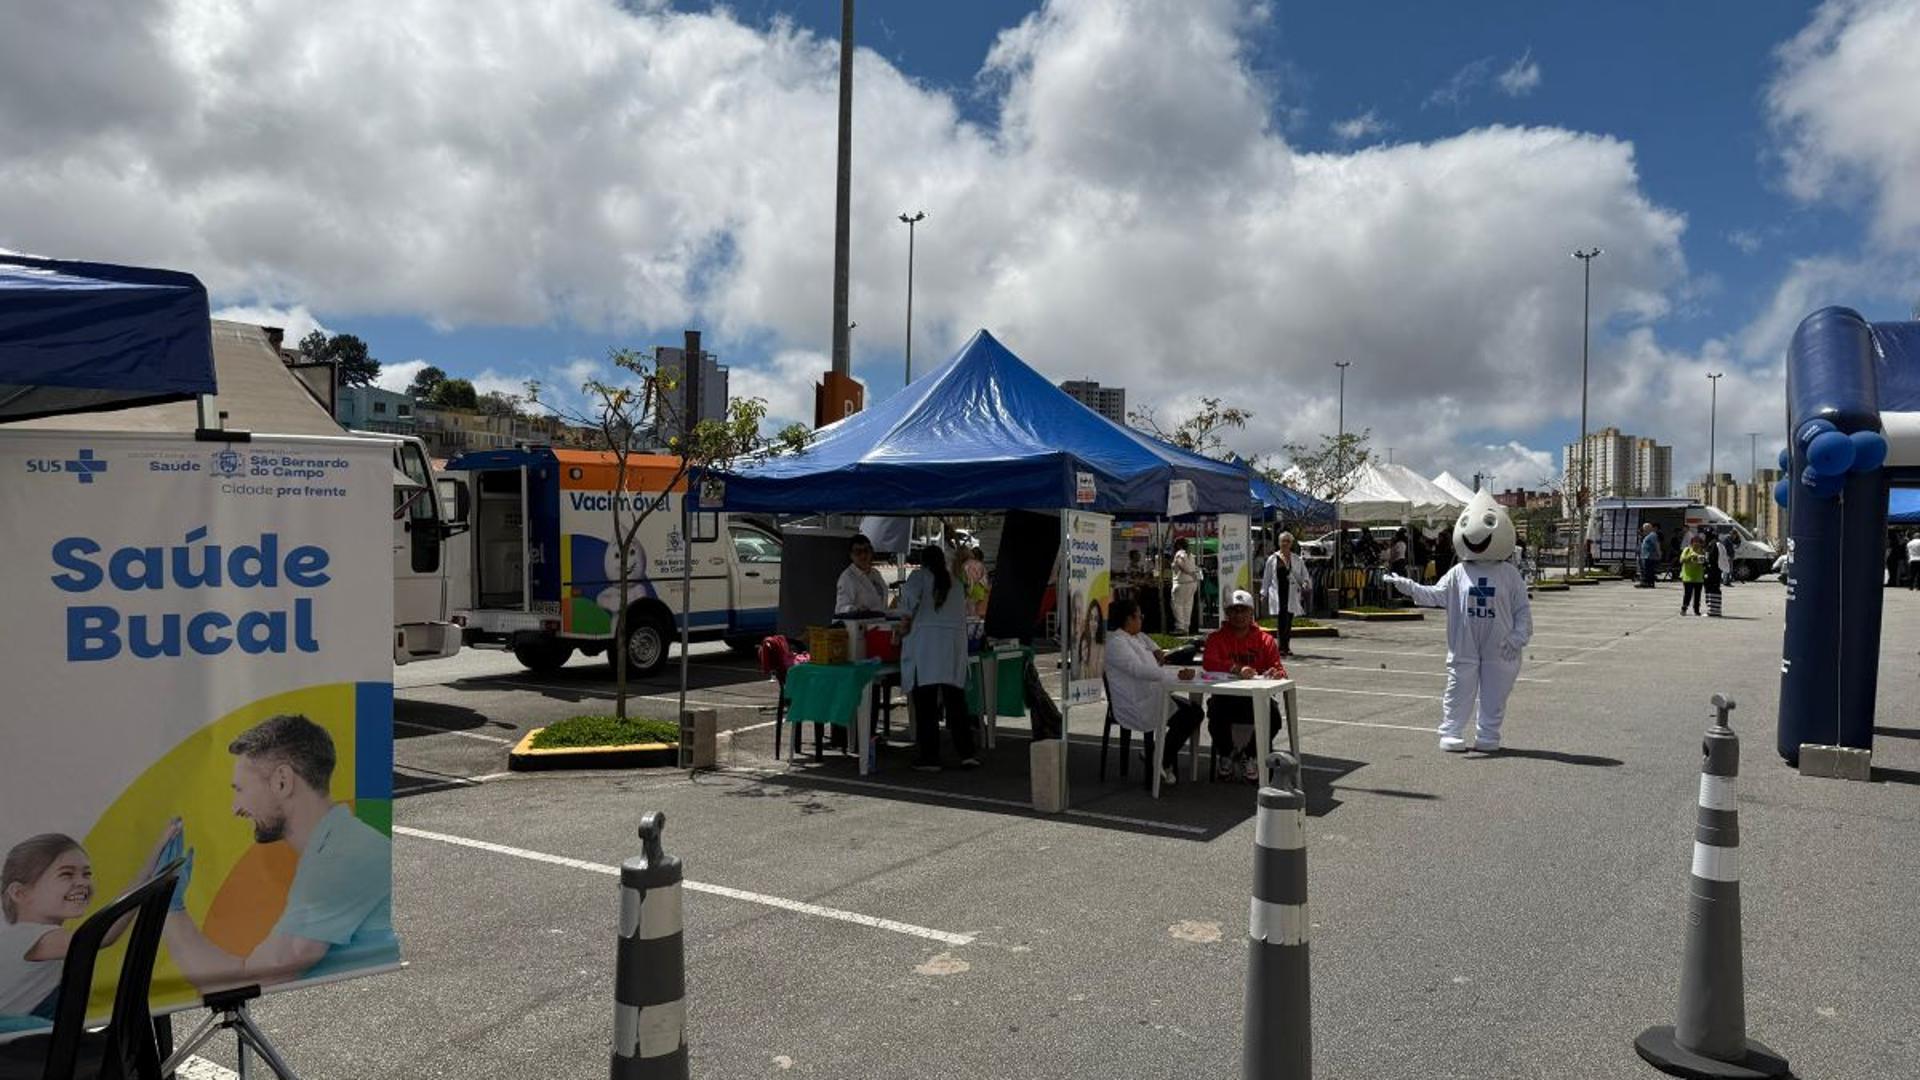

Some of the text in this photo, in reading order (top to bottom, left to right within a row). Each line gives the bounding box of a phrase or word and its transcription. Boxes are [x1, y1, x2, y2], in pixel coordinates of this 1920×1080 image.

[26, 459, 62, 473] SUS
[250, 455, 349, 469] São Bernardo
[250, 465, 324, 480] do Campo
[221, 483, 347, 499] Cidade pra frente
[570, 491, 671, 513] Vacimóvel
[51, 525, 332, 593] Saúde
[1467, 607, 1496, 618] SUS
[66, 598, 320, 662] Bucal
